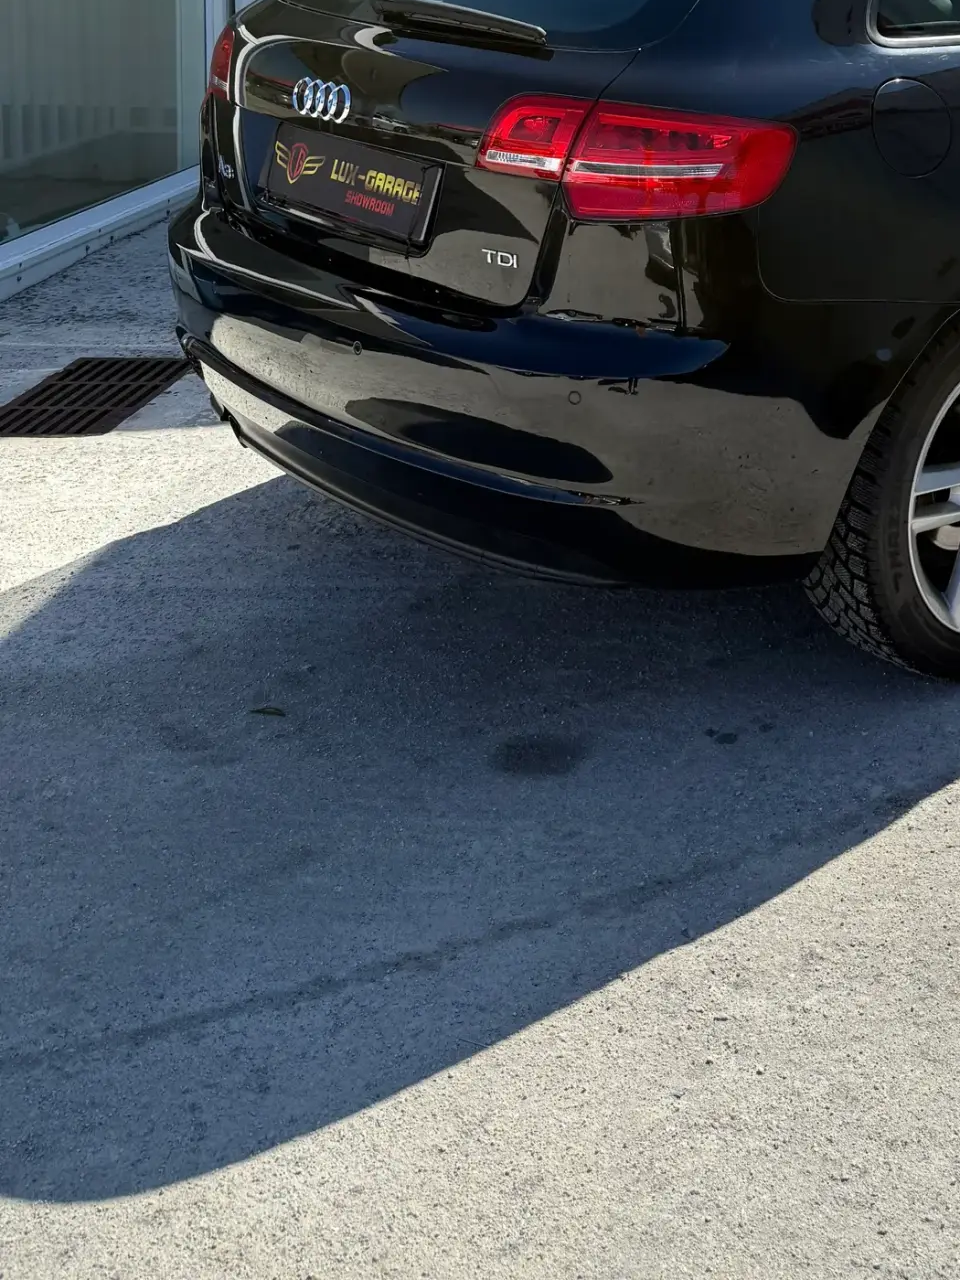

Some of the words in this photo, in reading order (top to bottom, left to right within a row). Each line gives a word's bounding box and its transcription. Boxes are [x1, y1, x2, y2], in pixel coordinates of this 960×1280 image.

[330, 159, 422, 206] LUX-GARAGE
[344, 190, 394, 217] SHOWROOM
[481, 248, 518, 269] TDI
